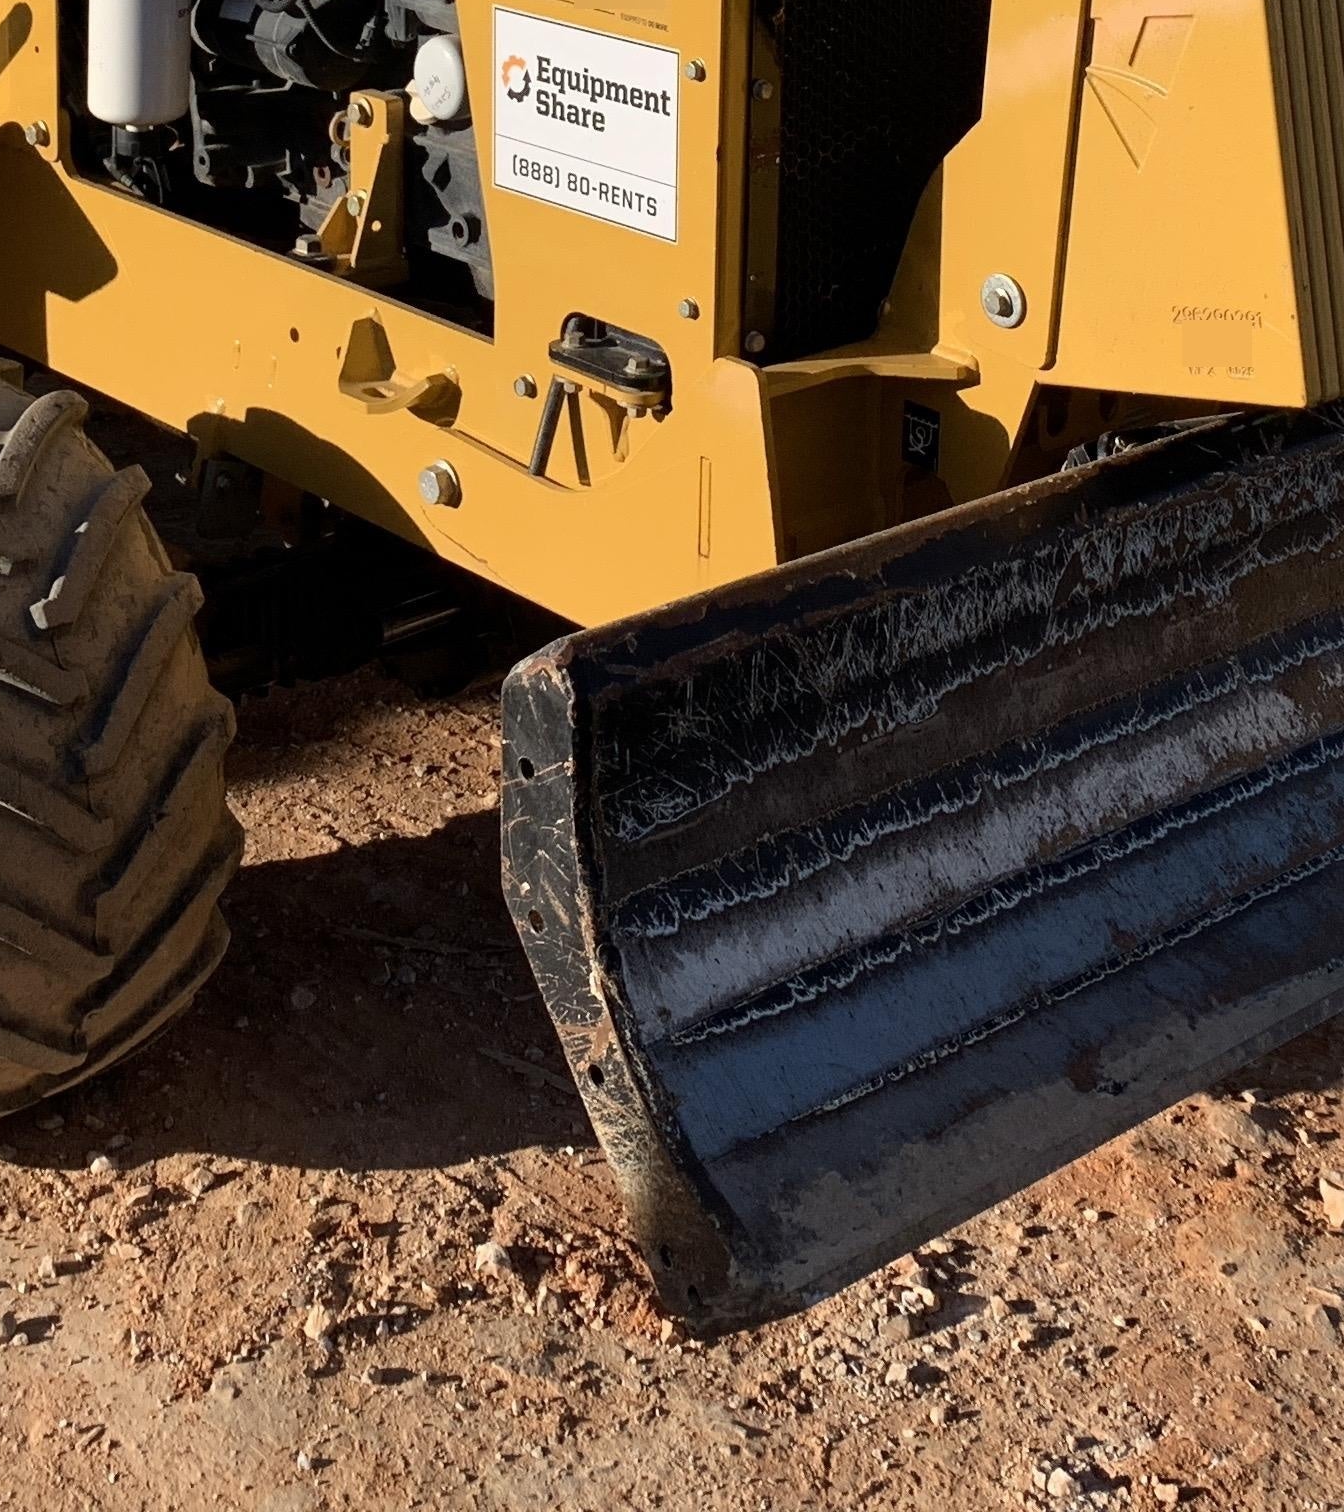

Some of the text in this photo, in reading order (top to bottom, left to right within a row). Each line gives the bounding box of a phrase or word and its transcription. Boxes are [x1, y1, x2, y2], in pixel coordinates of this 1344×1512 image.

[535, 89, 606, 133] Share
[536, 54, 671, 117] Equipment
[512, 154, 658, 218] (888) 80-RENTS
